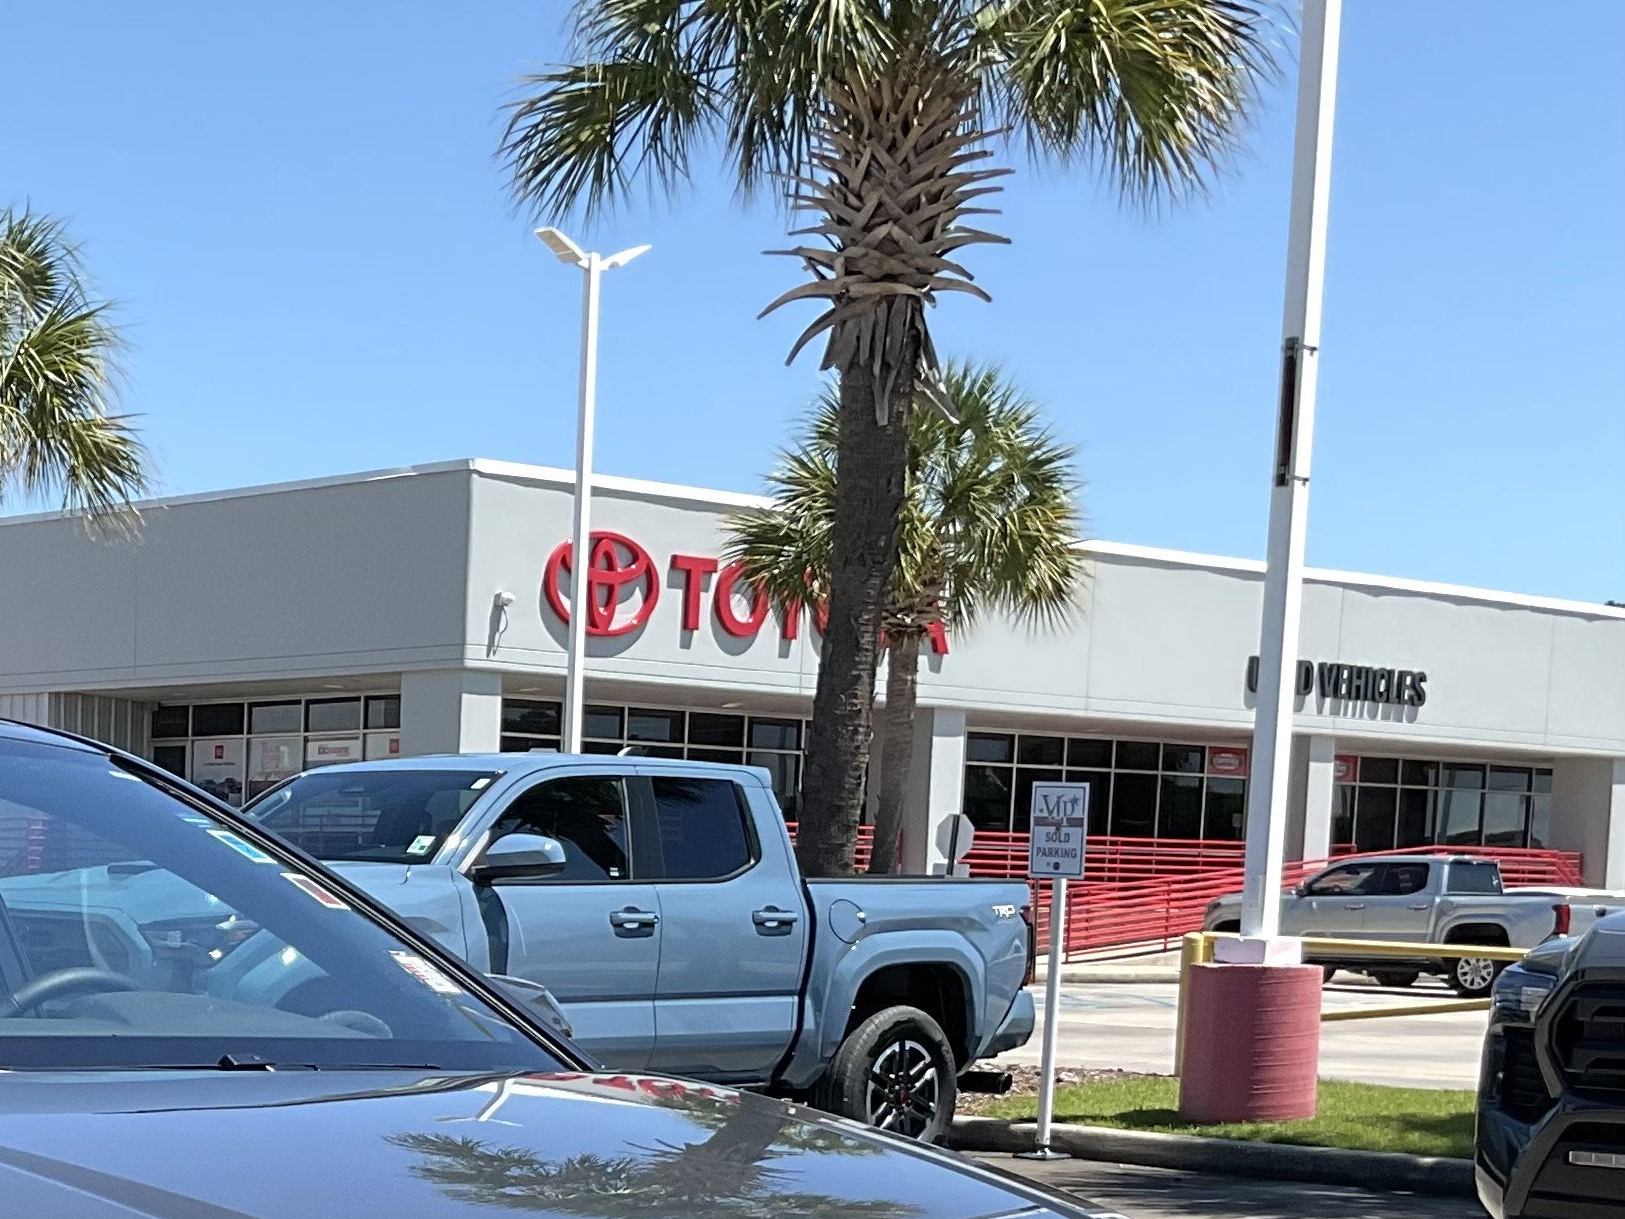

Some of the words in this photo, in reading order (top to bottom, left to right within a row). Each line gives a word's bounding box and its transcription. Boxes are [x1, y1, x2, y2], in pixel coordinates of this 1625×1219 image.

[1317, 662, 1427, 708] VEHICLES
[1045, 831, 1071, 844] SOLD
[1035, 846, 1078, 860] PARKING
[991, 904, 1016, 918] TRD
